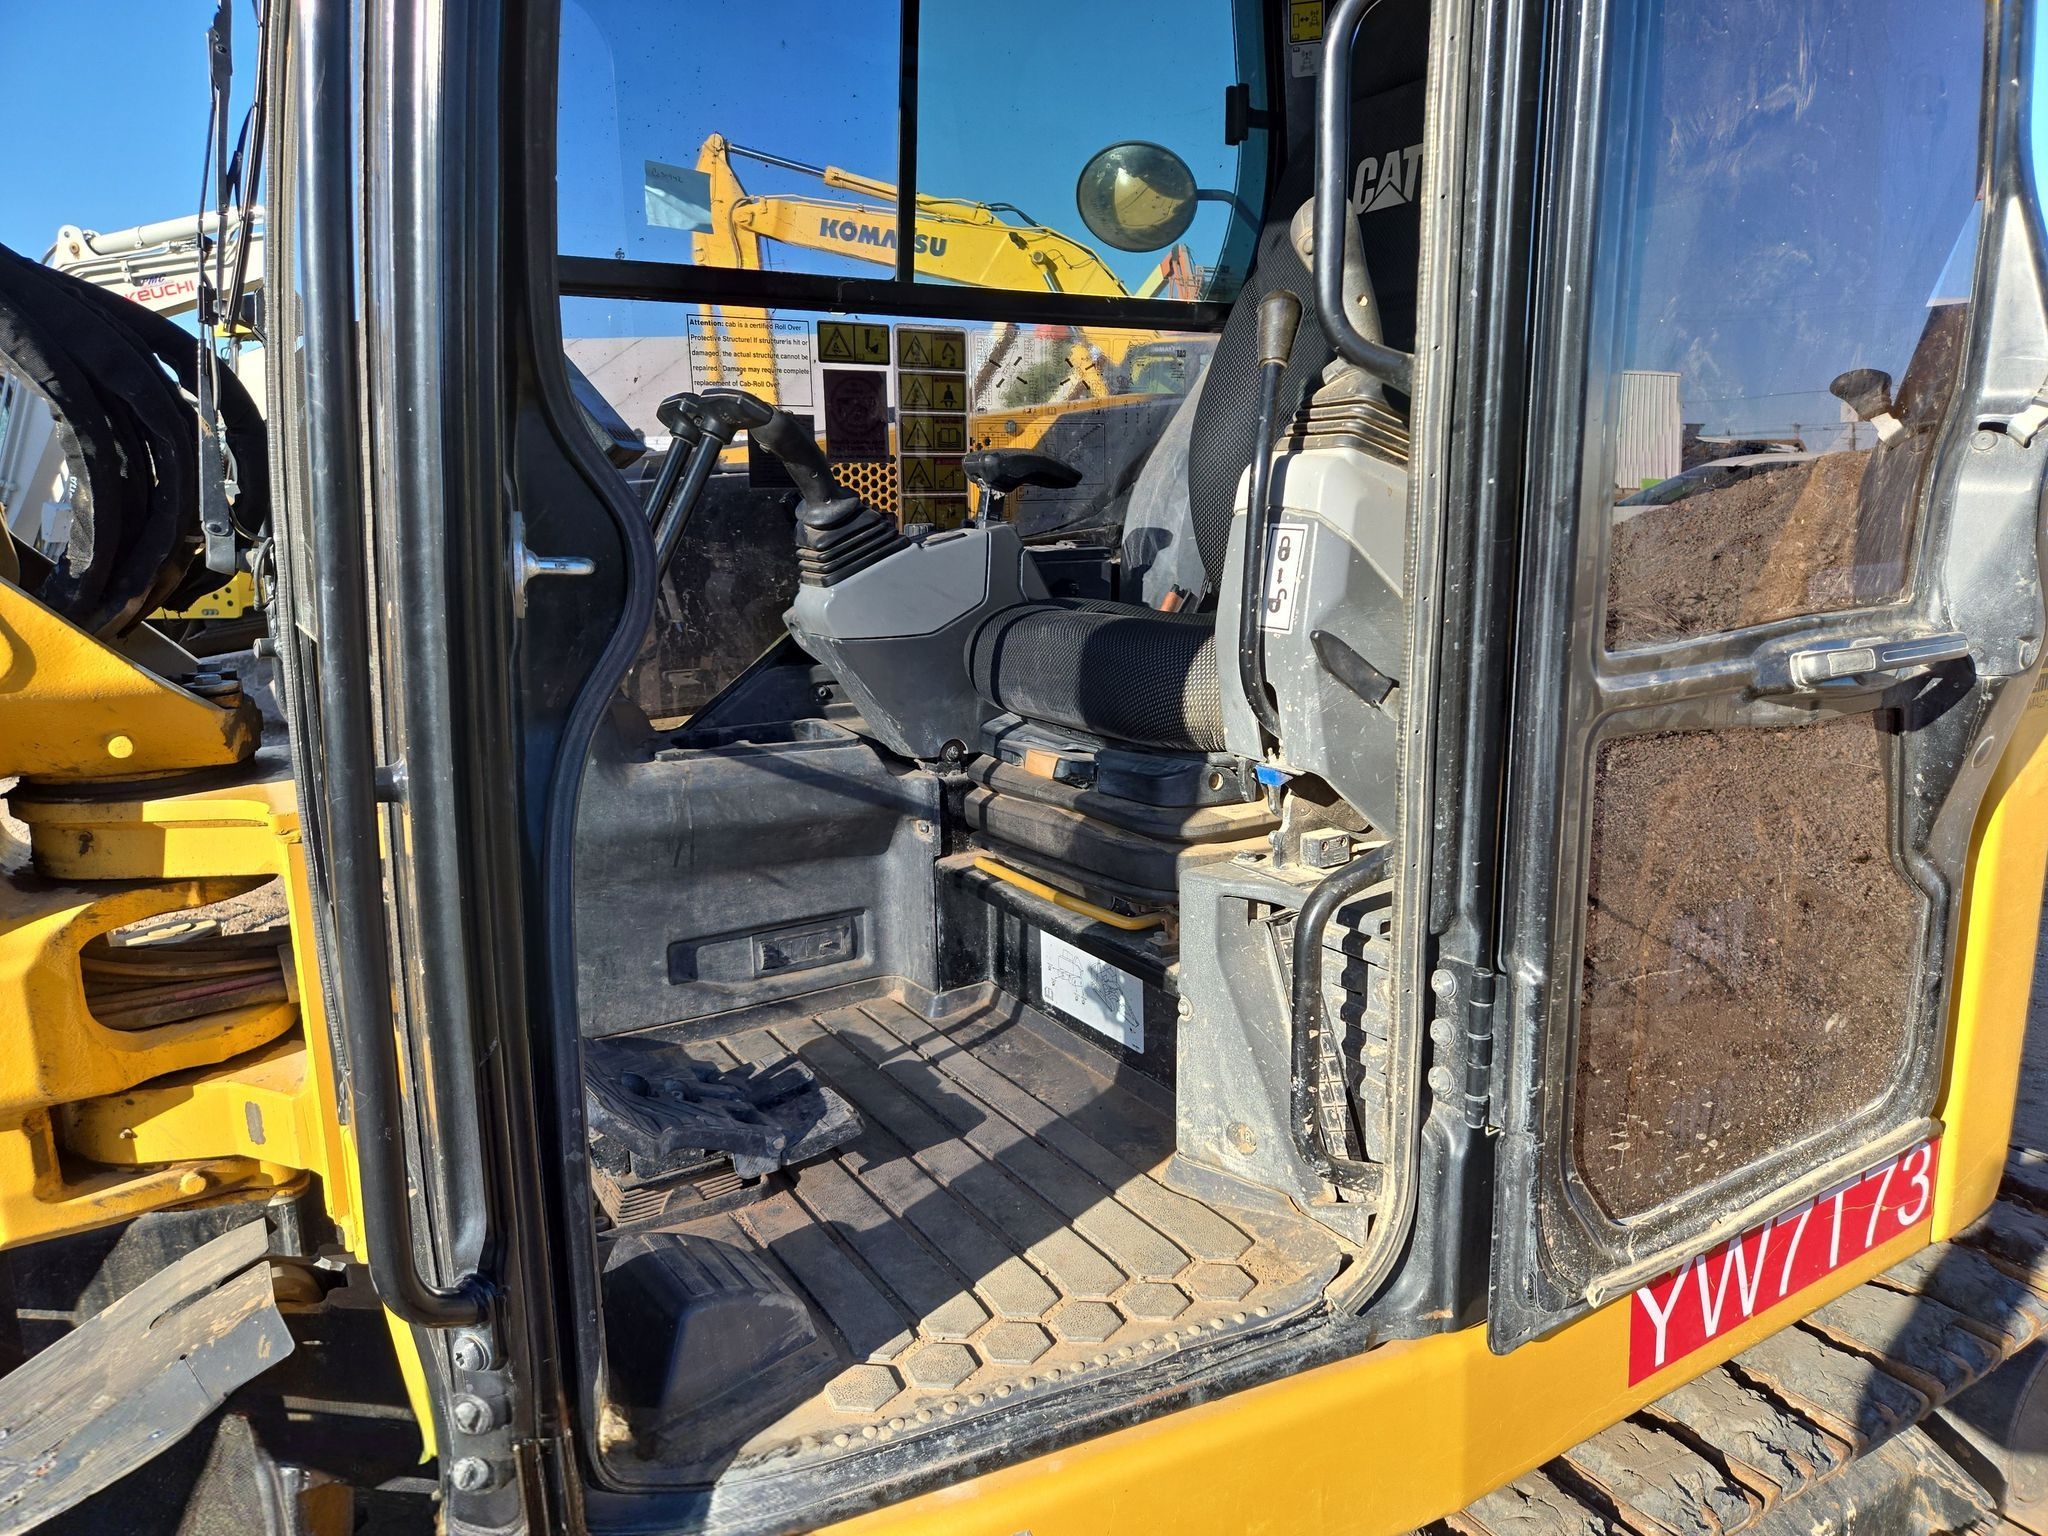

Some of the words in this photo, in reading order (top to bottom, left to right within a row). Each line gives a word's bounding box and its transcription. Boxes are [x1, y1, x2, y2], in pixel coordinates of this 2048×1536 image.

[1353, 143, 1423, 215] CAT
[819, 217, 947, 257] KOMASU
[690, 319, 724, 327] Attention:
[725, 320, 736, 328] cab
[749, 322, 774, 330] certified
[690, 333, 722, 342] Protective
[758, 337, 785, 345] structure
[792, 338, 801, 346] hit
[752, 352, 780, 360] structure
[722, 365, 747, 376] Damage
[694, 380, 731, 388] replacement
[739, 380, 765, 388] Cab-Roll
[1636, 1142, 1931, 1368] YW7T73
